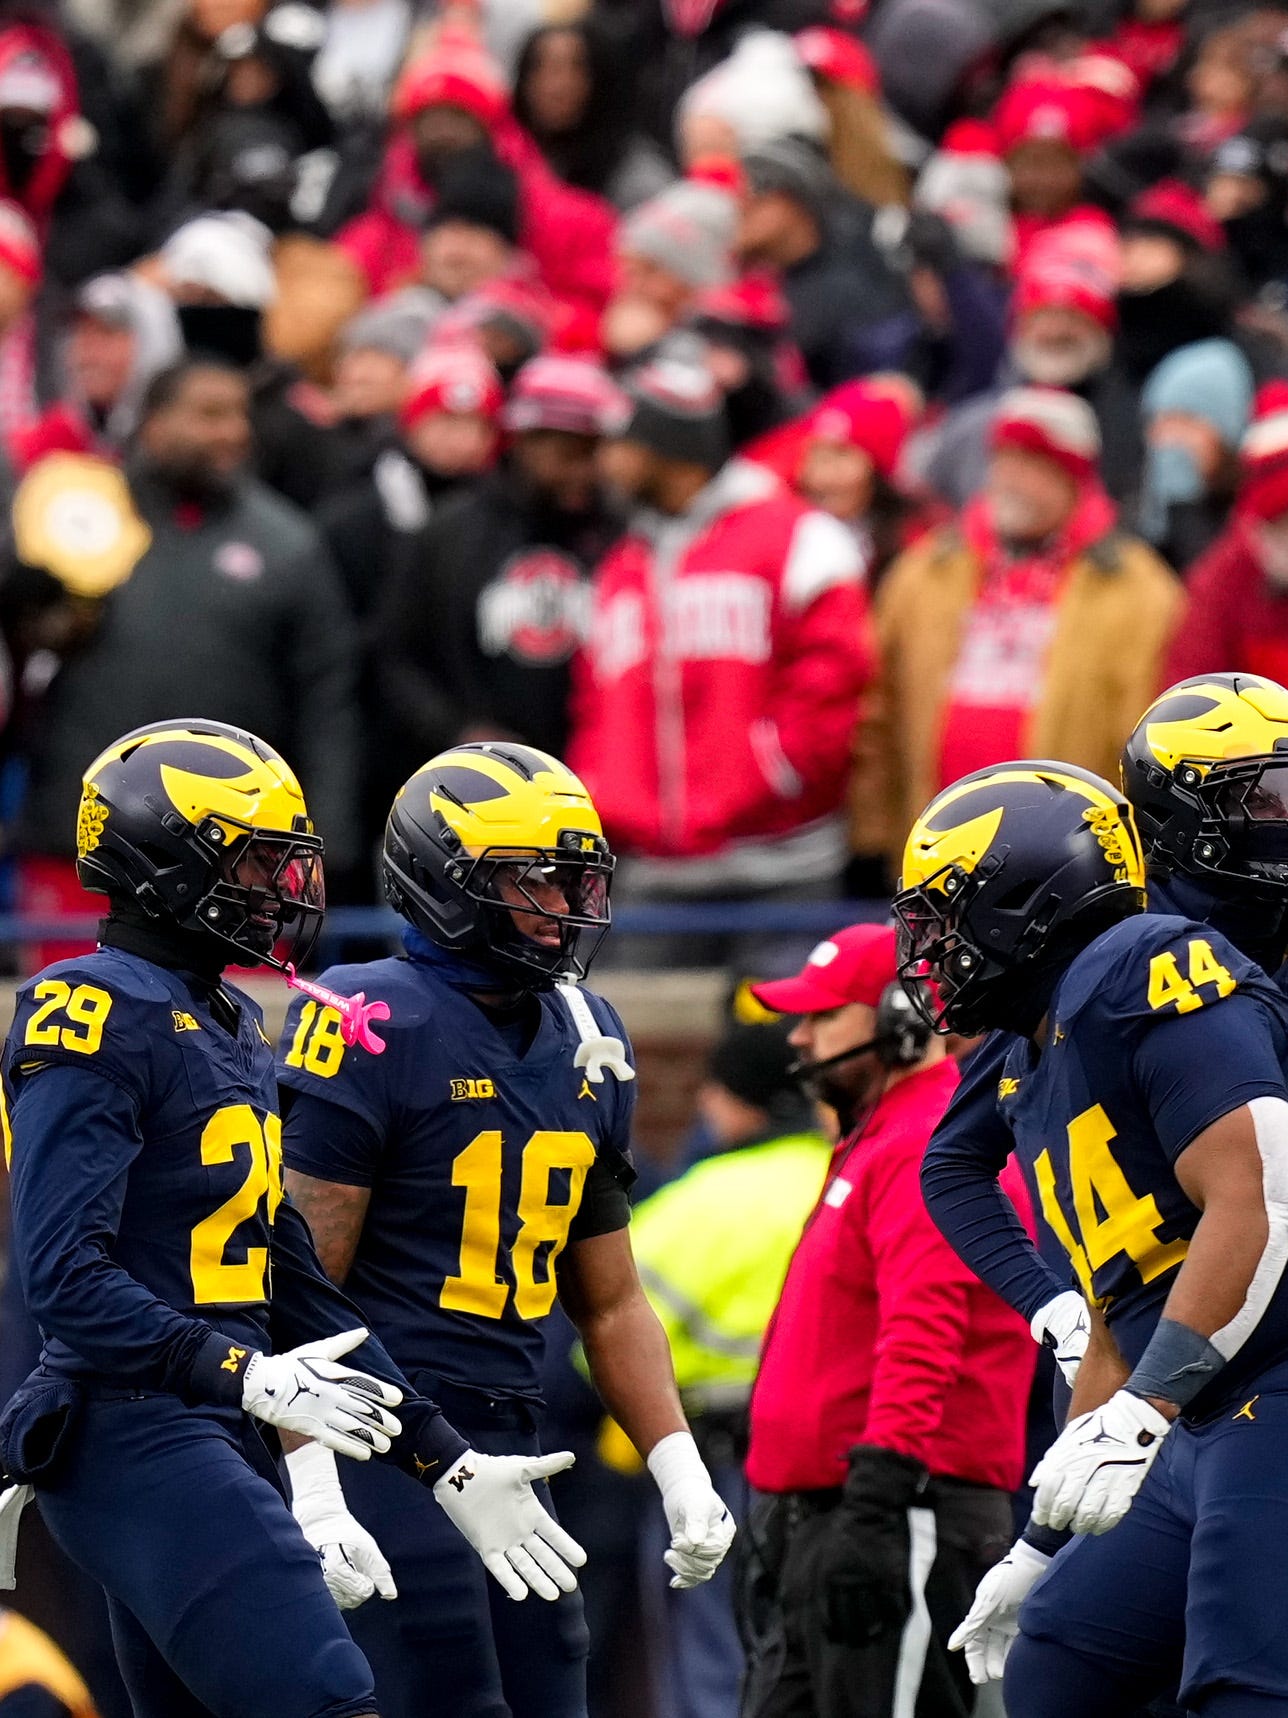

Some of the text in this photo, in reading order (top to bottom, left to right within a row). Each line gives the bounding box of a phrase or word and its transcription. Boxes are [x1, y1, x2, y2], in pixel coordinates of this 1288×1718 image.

[580, 837, 596, 851] M
[1147, 939, 1237, 1014] 44
[25, 979, 113, 1054] 29
[284, 999, 348, 1079] 18
[439, 1130, 598, 1321] 18
[221, 1346, 247, 1374] M
[447, 1465, 475, 1494] M
